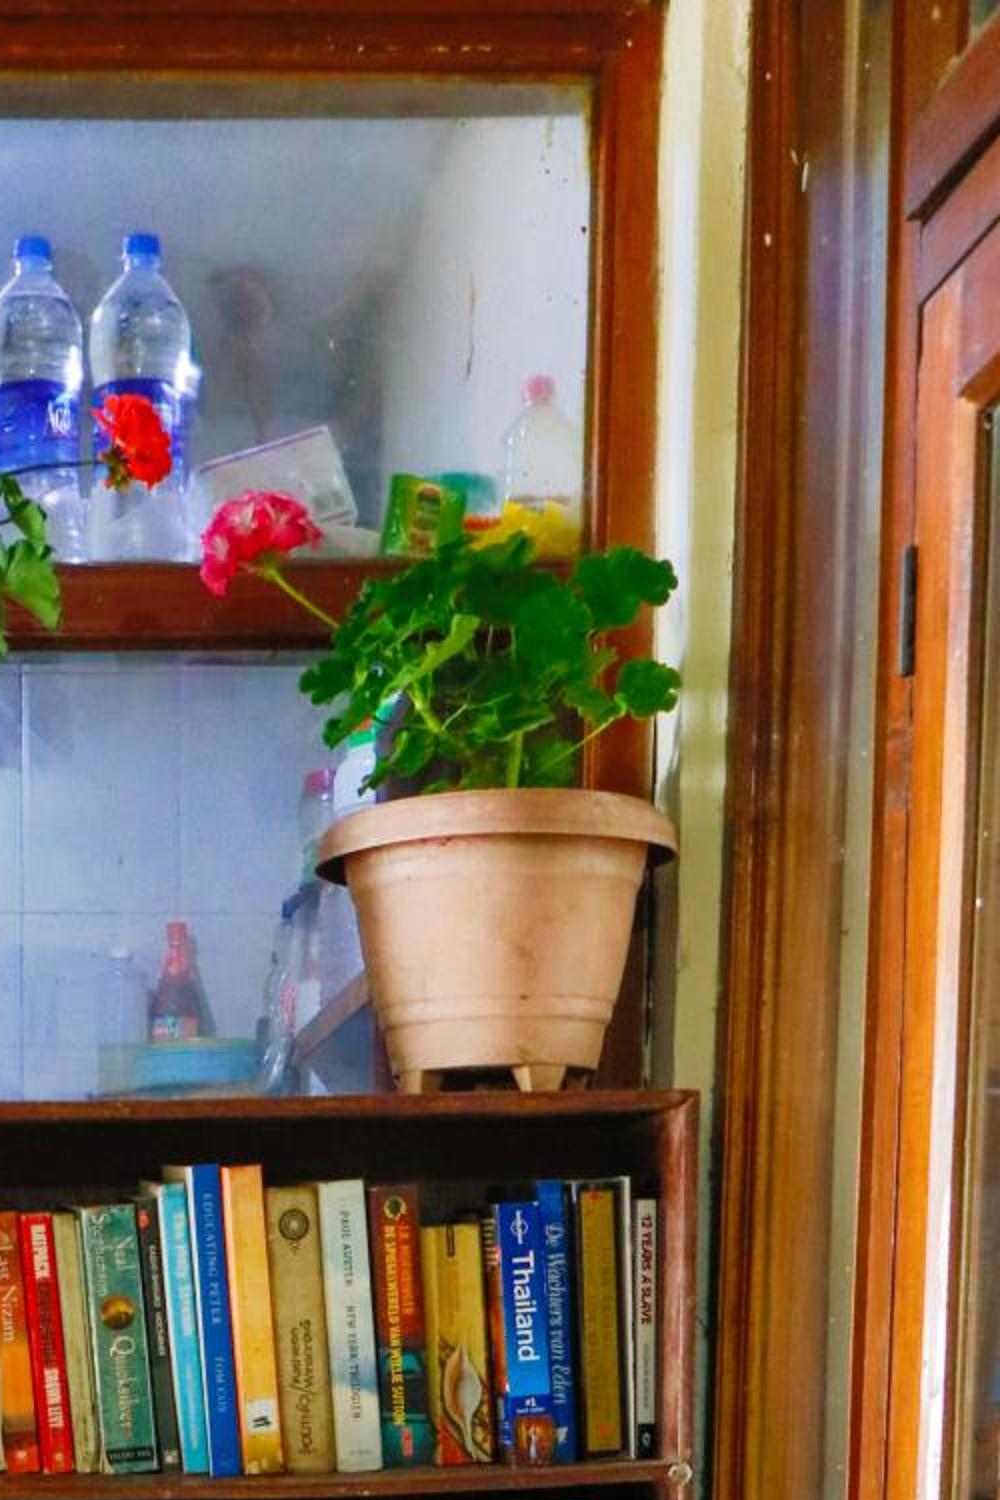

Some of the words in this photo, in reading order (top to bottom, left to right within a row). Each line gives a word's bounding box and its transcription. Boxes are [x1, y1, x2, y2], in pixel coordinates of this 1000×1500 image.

[201, 1192, 219, 1277] EDUCATING
[339, 1210, 351, 1239] PAUL
[545, 1224, 566, 1247] De
[640, 1215, 652, 1229] 12
[113, 1234, 137, 1271] Neal
[640, 1232, 653, 1272] YEARS
[547, 1252, 570, 1328] Wachters
[641, 1275, 651, 1285] A
[0, 1286, 19, 1343] Nizam
[208, 1281, 222, 1326] PETER
[512, 1252, 540, 1361] Thailand
[641, 1287, 652, 1326] SLAVE
[389, 1326, 402, 1349] VAN
[551, 1330, 565, 1361] van
[109, 1335, 137, 1431] Quicksilver
[213, 1357, 227, 1384] TOM
[552, 1364, 570, 1404] Eden
[393, 1385, 406, 1425] SUTTON
